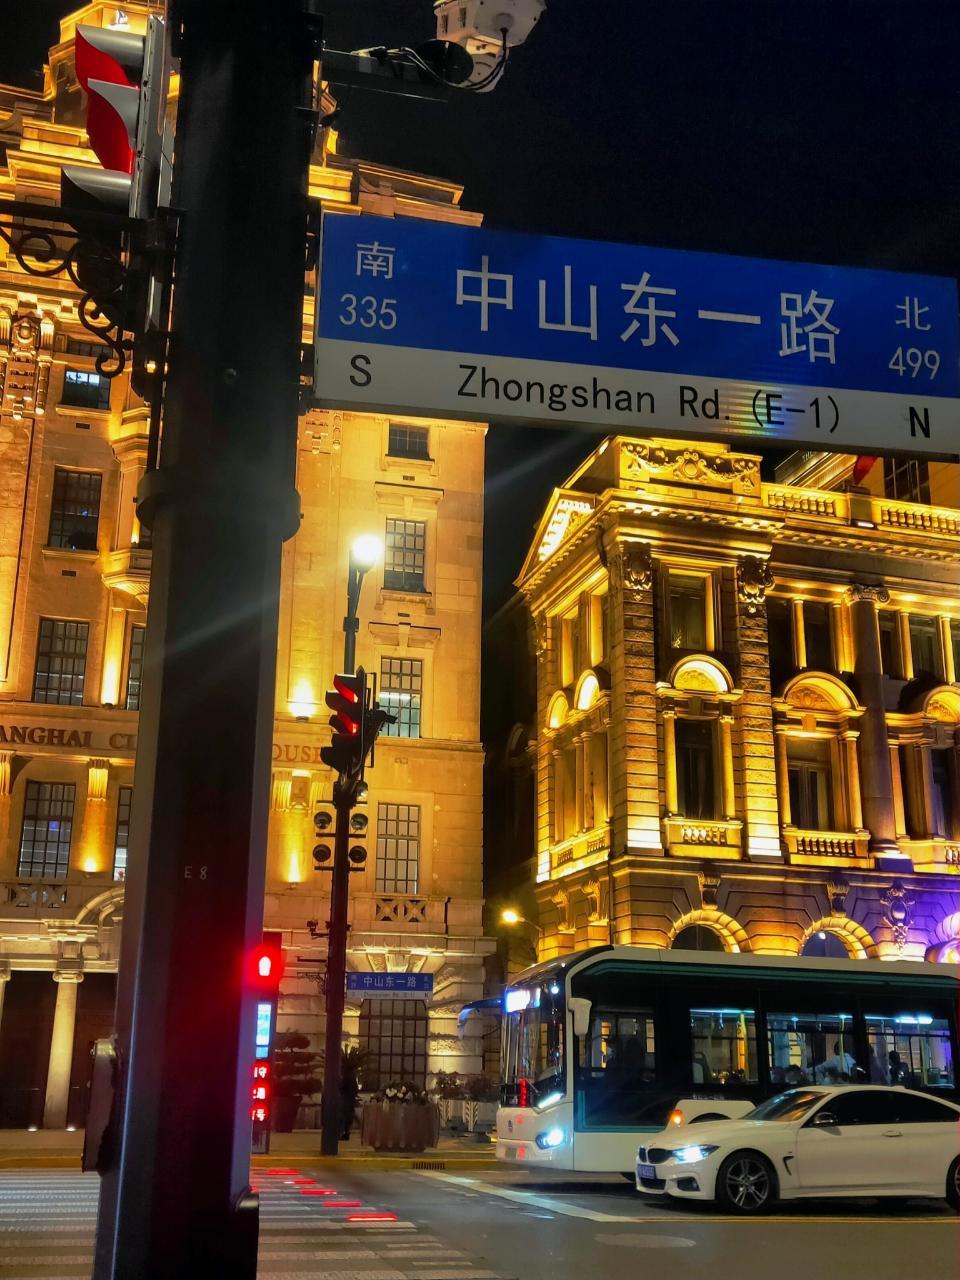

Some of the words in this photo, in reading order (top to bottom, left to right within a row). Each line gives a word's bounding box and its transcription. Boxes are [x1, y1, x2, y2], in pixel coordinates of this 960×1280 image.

[356, 241, 397, 279] 南
[339, 293, 397, 330] 335
[456, 255, 840, 364] 中山东一路
[895, 296, 932, 331] 北
[349, 354, 372, 387] S
[888, 346, 941, 380] 499
[457, 364, 655, 414] Zhongshan
[679, 385, 730, 420] Rd.
[752, 389, 840, 433] (E-1)
[908, 406, 931, 438] N
[363, 975, 417, 988] 中山东一路
